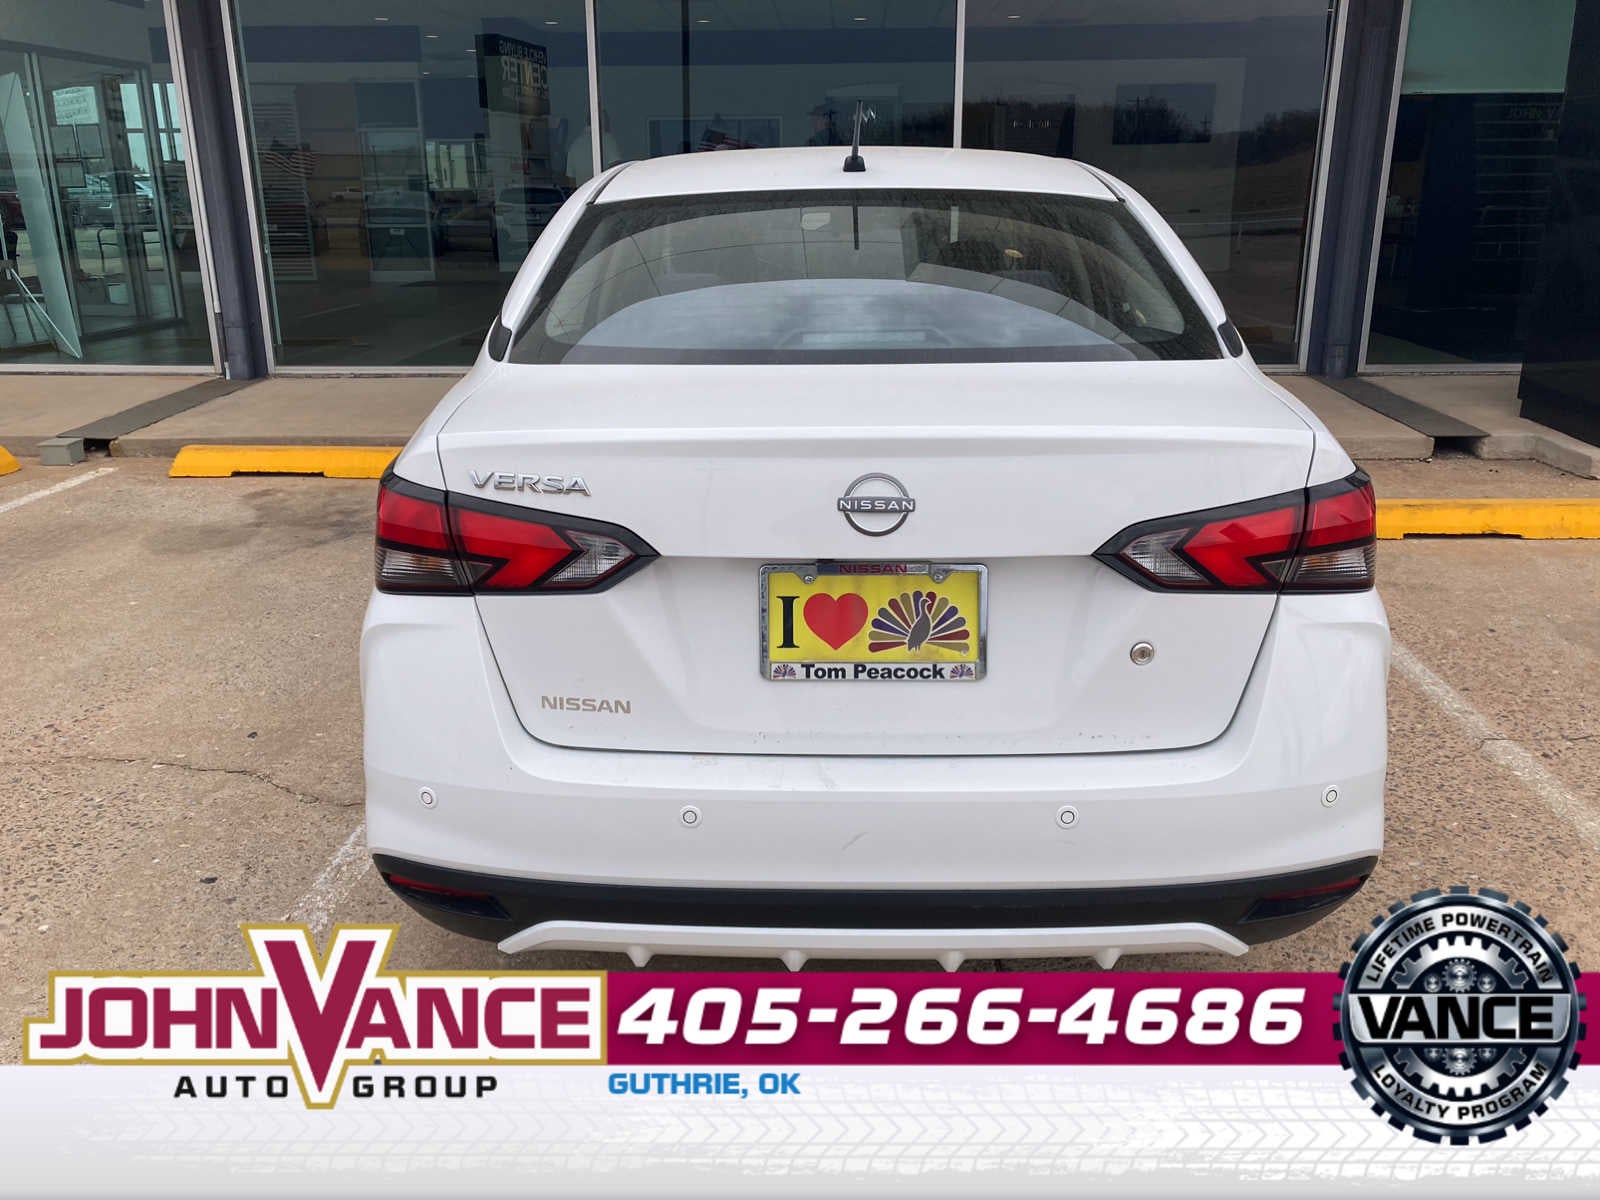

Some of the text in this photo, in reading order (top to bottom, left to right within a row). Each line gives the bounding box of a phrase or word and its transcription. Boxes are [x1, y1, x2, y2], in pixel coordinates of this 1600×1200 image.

[470, 470, 592, 497] VERSA
[839, 499, 915, 511] NISSAN
[839, 564, 908, 574] NISSAN
[776, 596, 800, 648] I
[801, 664, 945, 680] Tom Peacock
[541, 695, 632, 714] NISSAN
